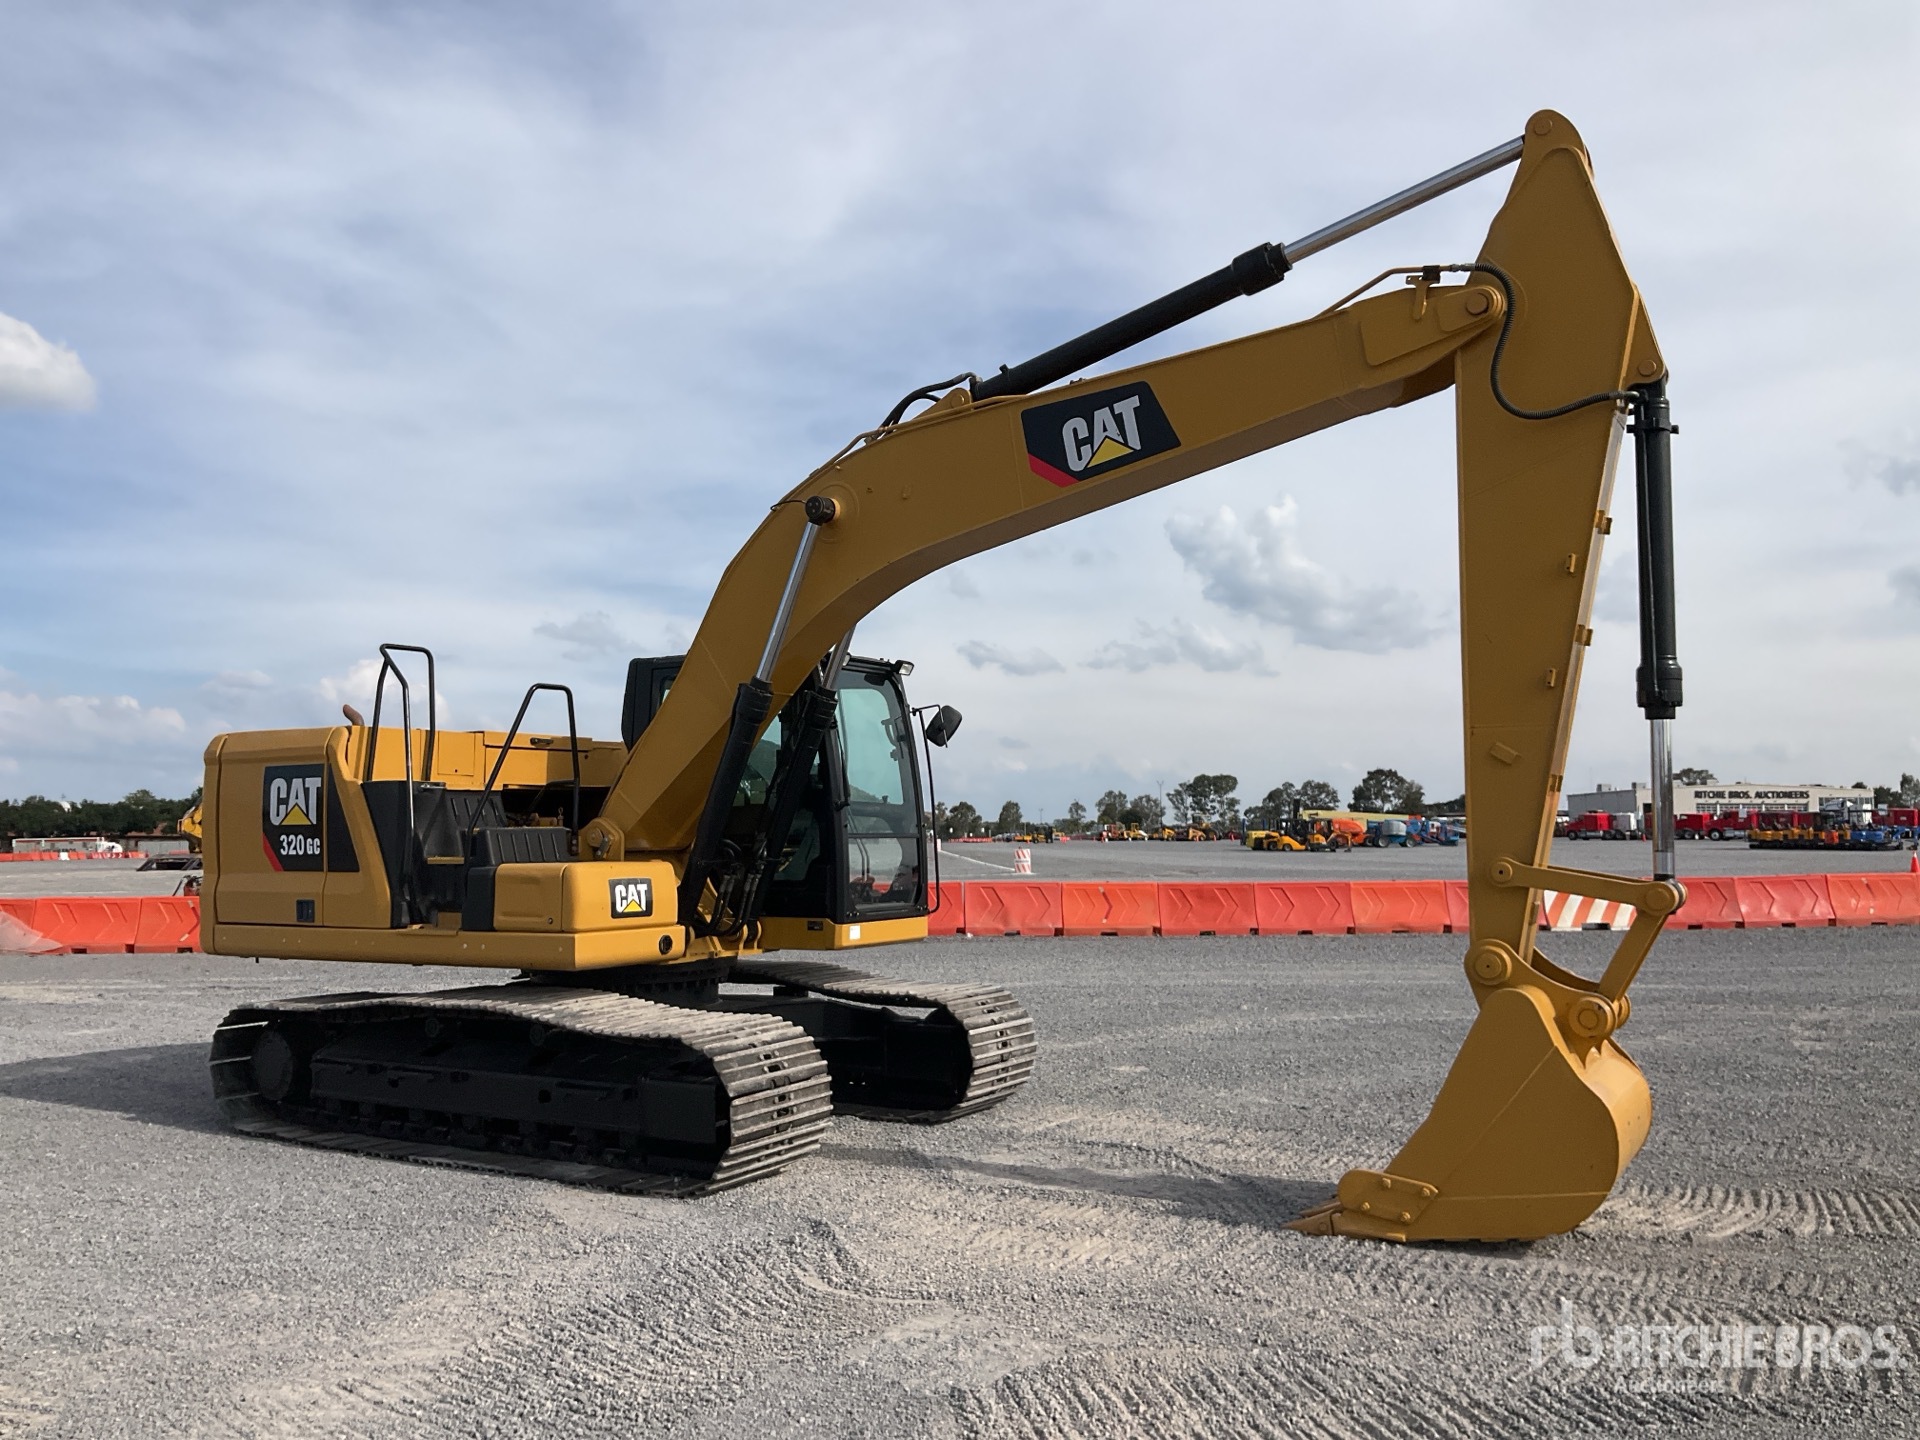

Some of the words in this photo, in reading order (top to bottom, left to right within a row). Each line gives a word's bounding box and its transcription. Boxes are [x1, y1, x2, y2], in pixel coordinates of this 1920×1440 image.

[1062, 395, 1141, 471] CAT
[270, 777, 321, 825] CAT
[1694, 790, 1726, 799] RITCHIE
[1728, 790, 1752, 799] BROS.
[1754, 790, 1810, 799] AUCTIONEERS
[280, 834, 304, 855] 320
[306, 838, 320, 854] GC
[614, 883, 647, 913] CAT
